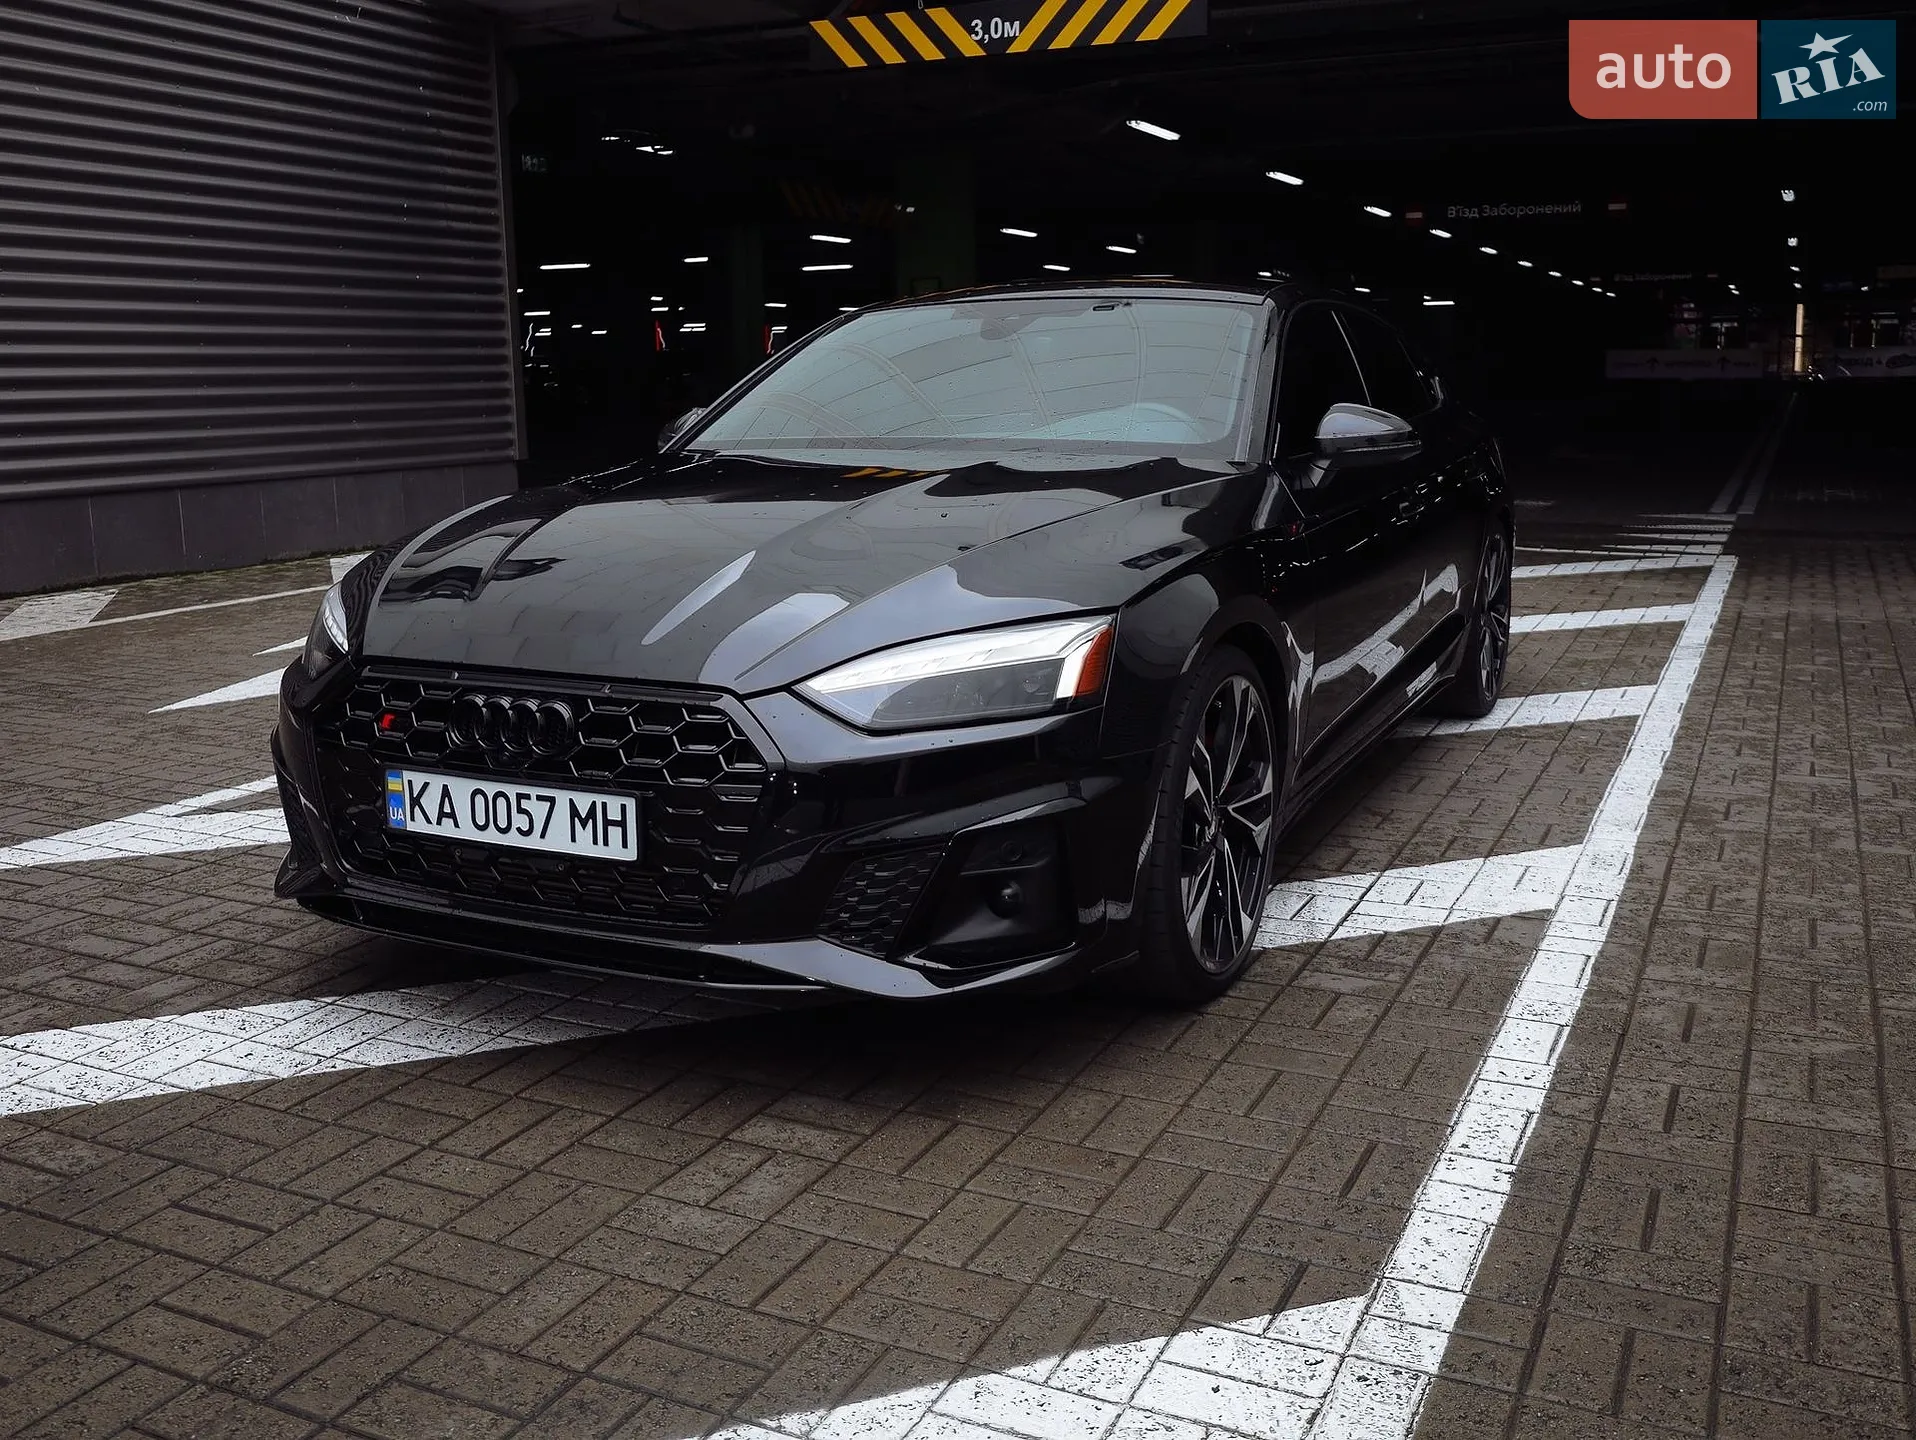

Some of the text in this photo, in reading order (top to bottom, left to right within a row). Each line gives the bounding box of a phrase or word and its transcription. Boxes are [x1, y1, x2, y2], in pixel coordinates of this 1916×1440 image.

[970, 18, 1020, 43] 3,0м
[1482, 201, 1582, 218] Заборонений
[389, 807, 405, 821] UA
[407, 779, 629, 849] KA 0057 MH
